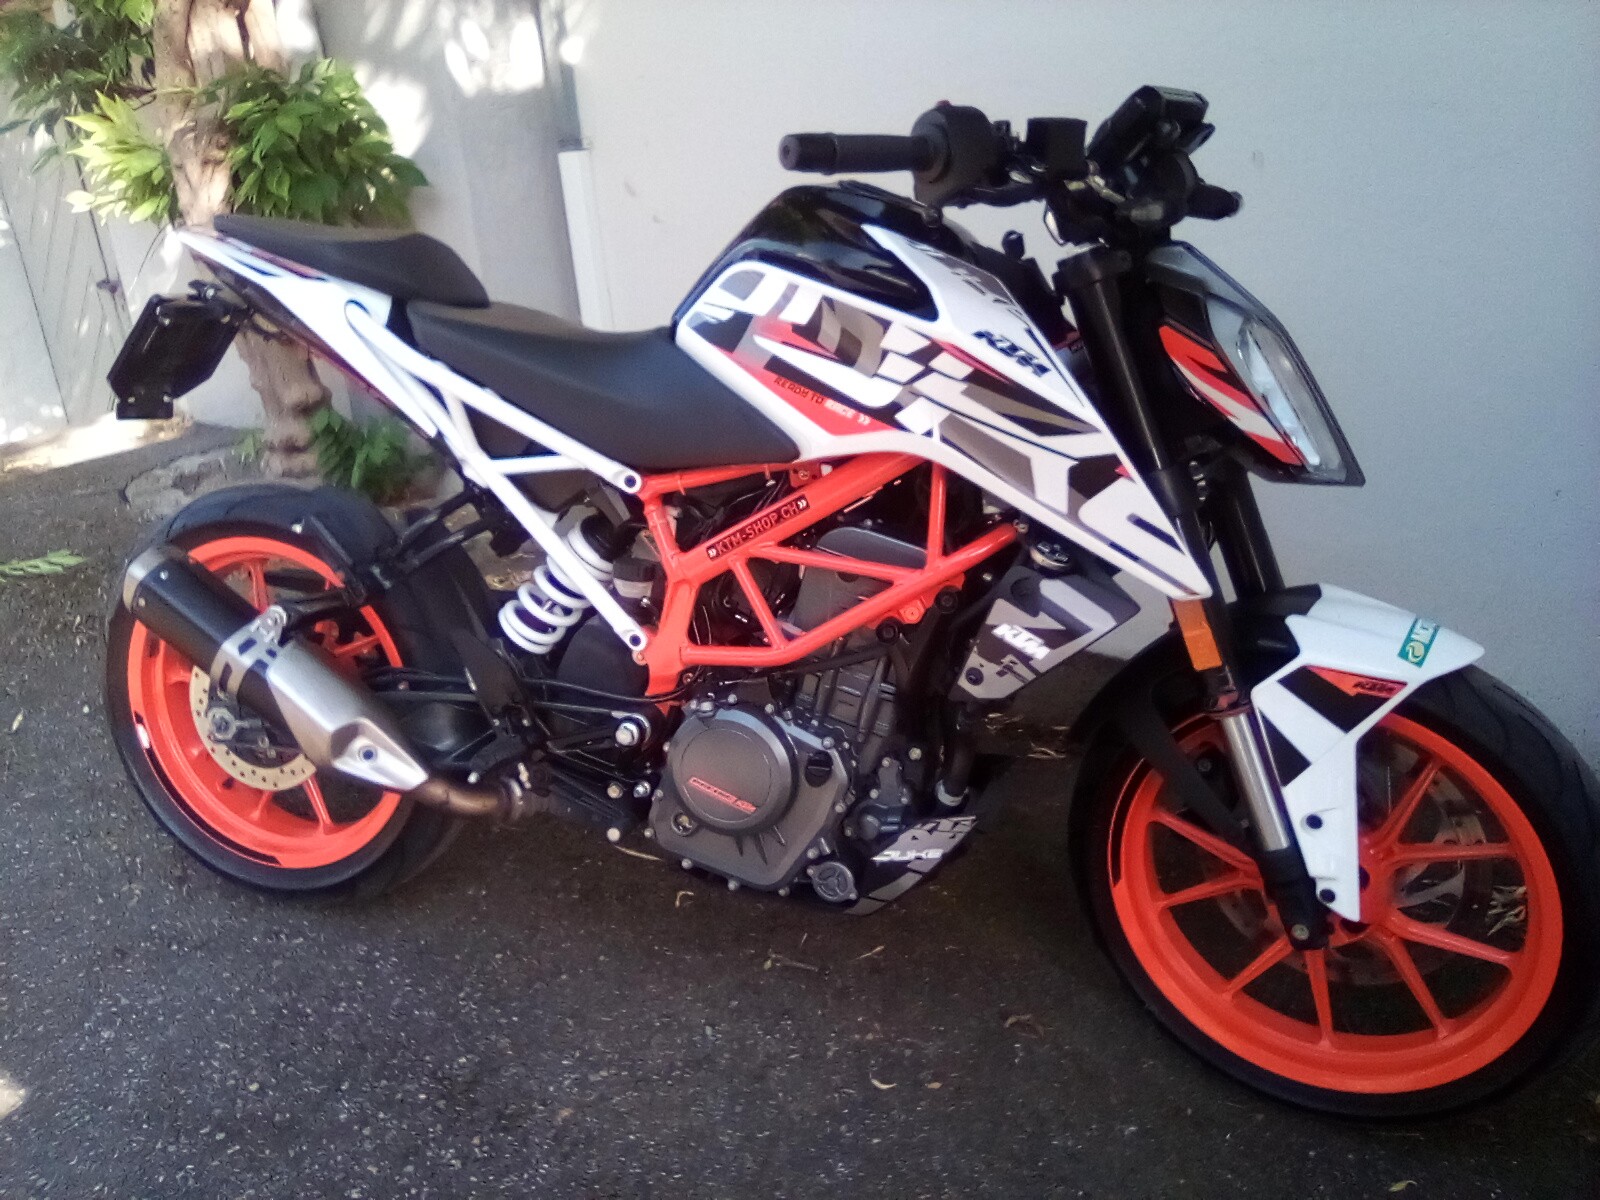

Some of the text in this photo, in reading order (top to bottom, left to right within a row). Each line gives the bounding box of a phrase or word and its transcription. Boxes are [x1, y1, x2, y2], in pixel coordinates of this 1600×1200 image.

[971, 330, 1051, 378] KTM
[774, 376, 810, 399] READY
[991, 623, 1050, 660] KTM
